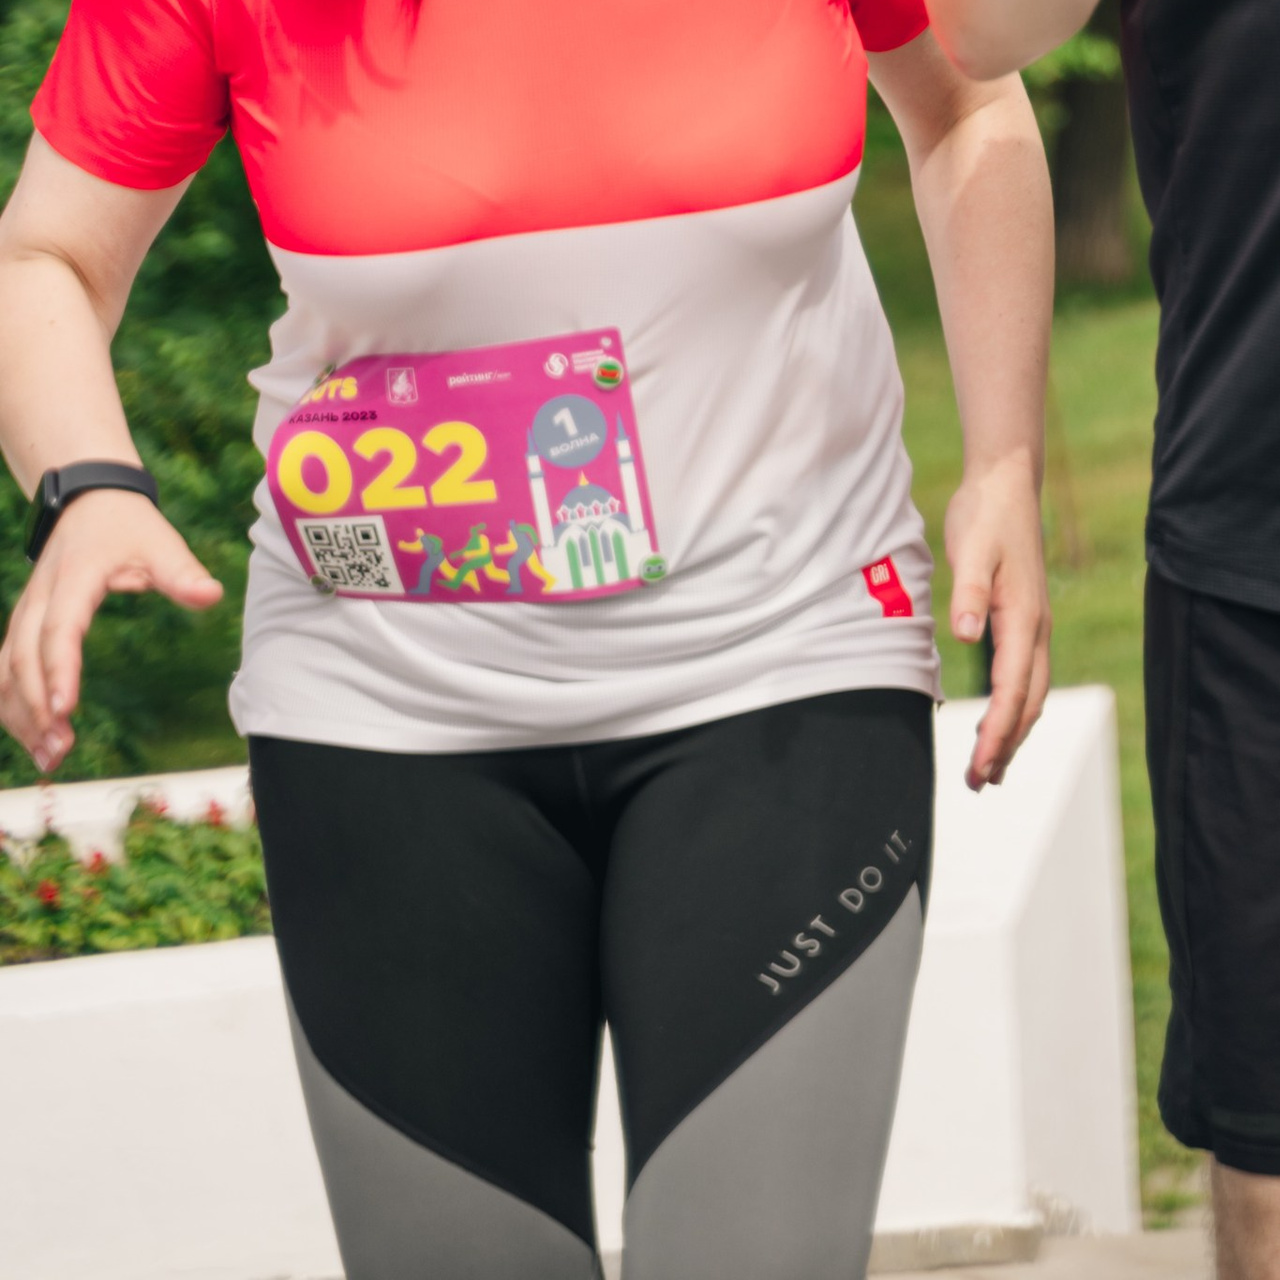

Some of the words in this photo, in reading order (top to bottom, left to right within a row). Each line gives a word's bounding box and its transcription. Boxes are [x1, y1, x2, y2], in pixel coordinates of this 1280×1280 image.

[289, 412, 339, 424] КАЗАНЬ
[342, 410, 378, 422] 2023
[553, 407, 579, 437] 1
[549, 432, 600, 458] ВОЛНА
[277, 421, 498, 514] 022
[757, 914, 836, 996] JUST
[838, 865, 883, 914] DO
